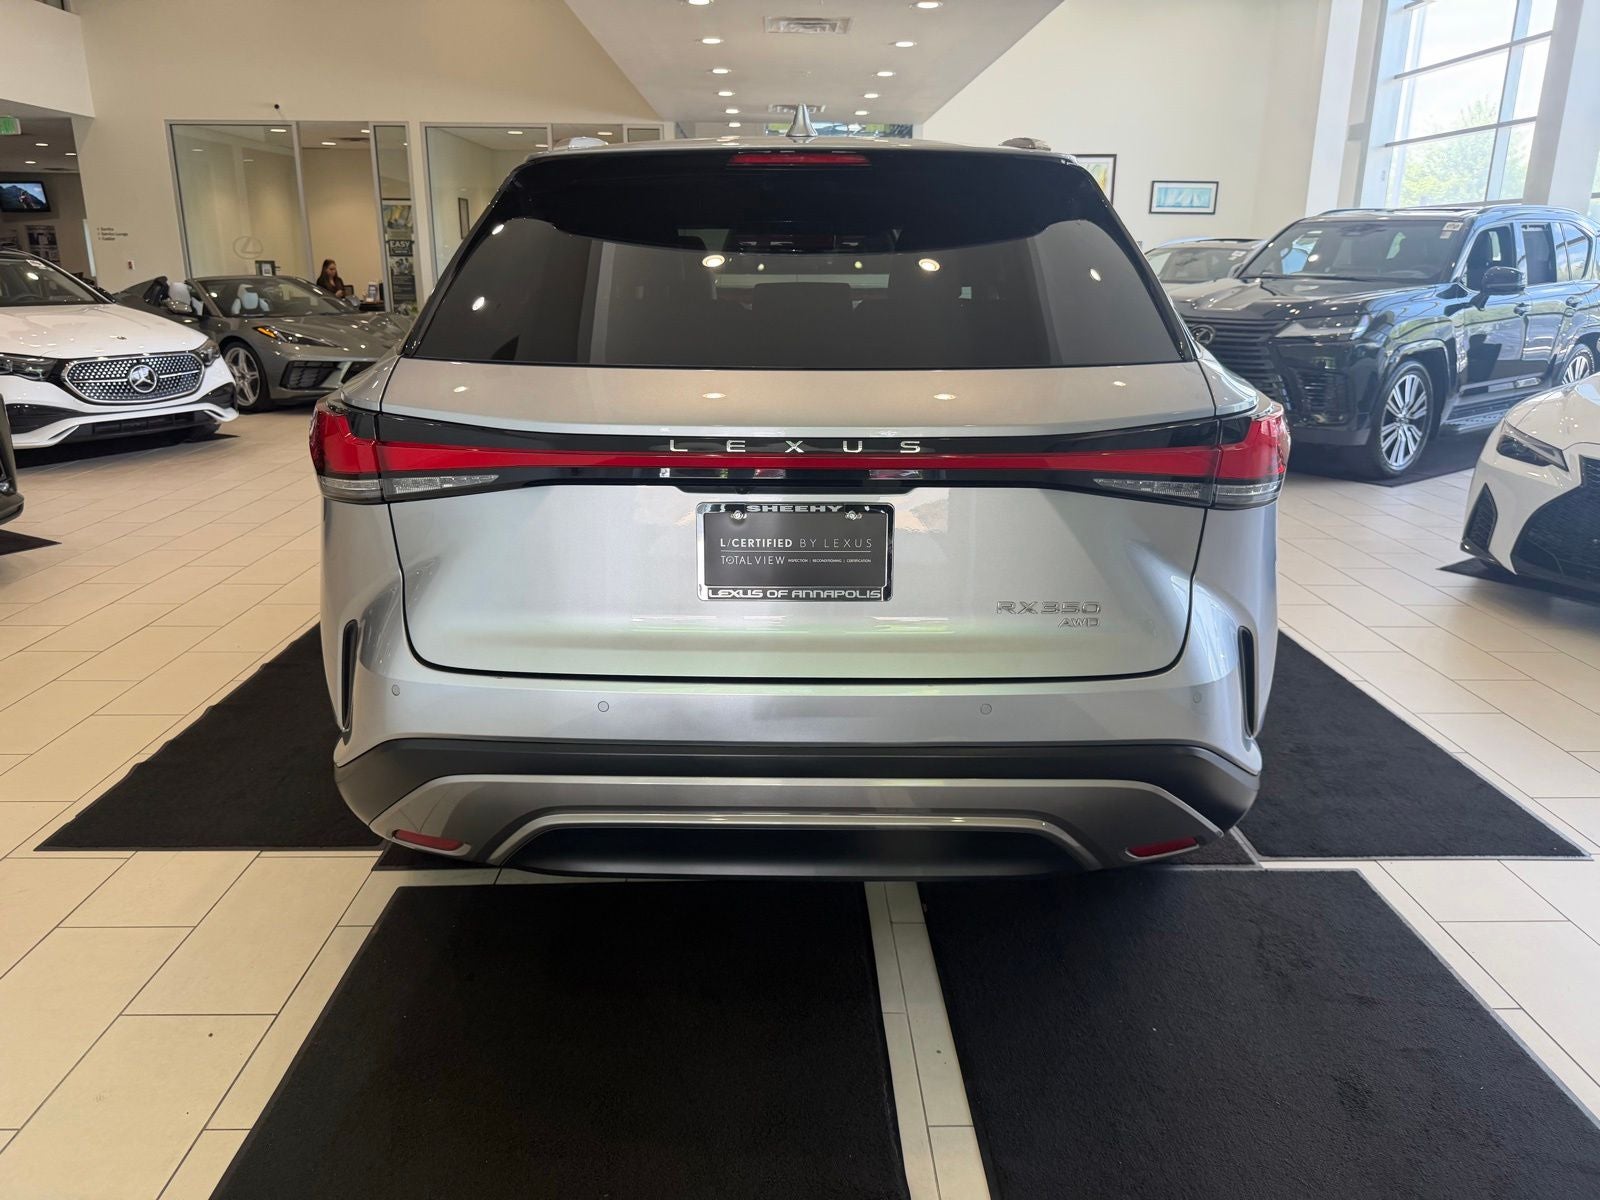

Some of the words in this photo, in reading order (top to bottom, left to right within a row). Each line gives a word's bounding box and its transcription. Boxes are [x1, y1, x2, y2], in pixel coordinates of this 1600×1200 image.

[669, 439, 921, 453] LEXUS
[720, 538, 793, 548] L/CERTIFIED
[799, 538, 817, 548] BY
[824, 538, 872, 548] LEXUS
[708, 589, 764, 598] LEXUS
[766, 589, 789, 598] OF
[791, 589, 881, 598] ANNAPOLIS
[996, 600, 1101, 615] RX350
[1057, 617, 1100, 628] AWD
